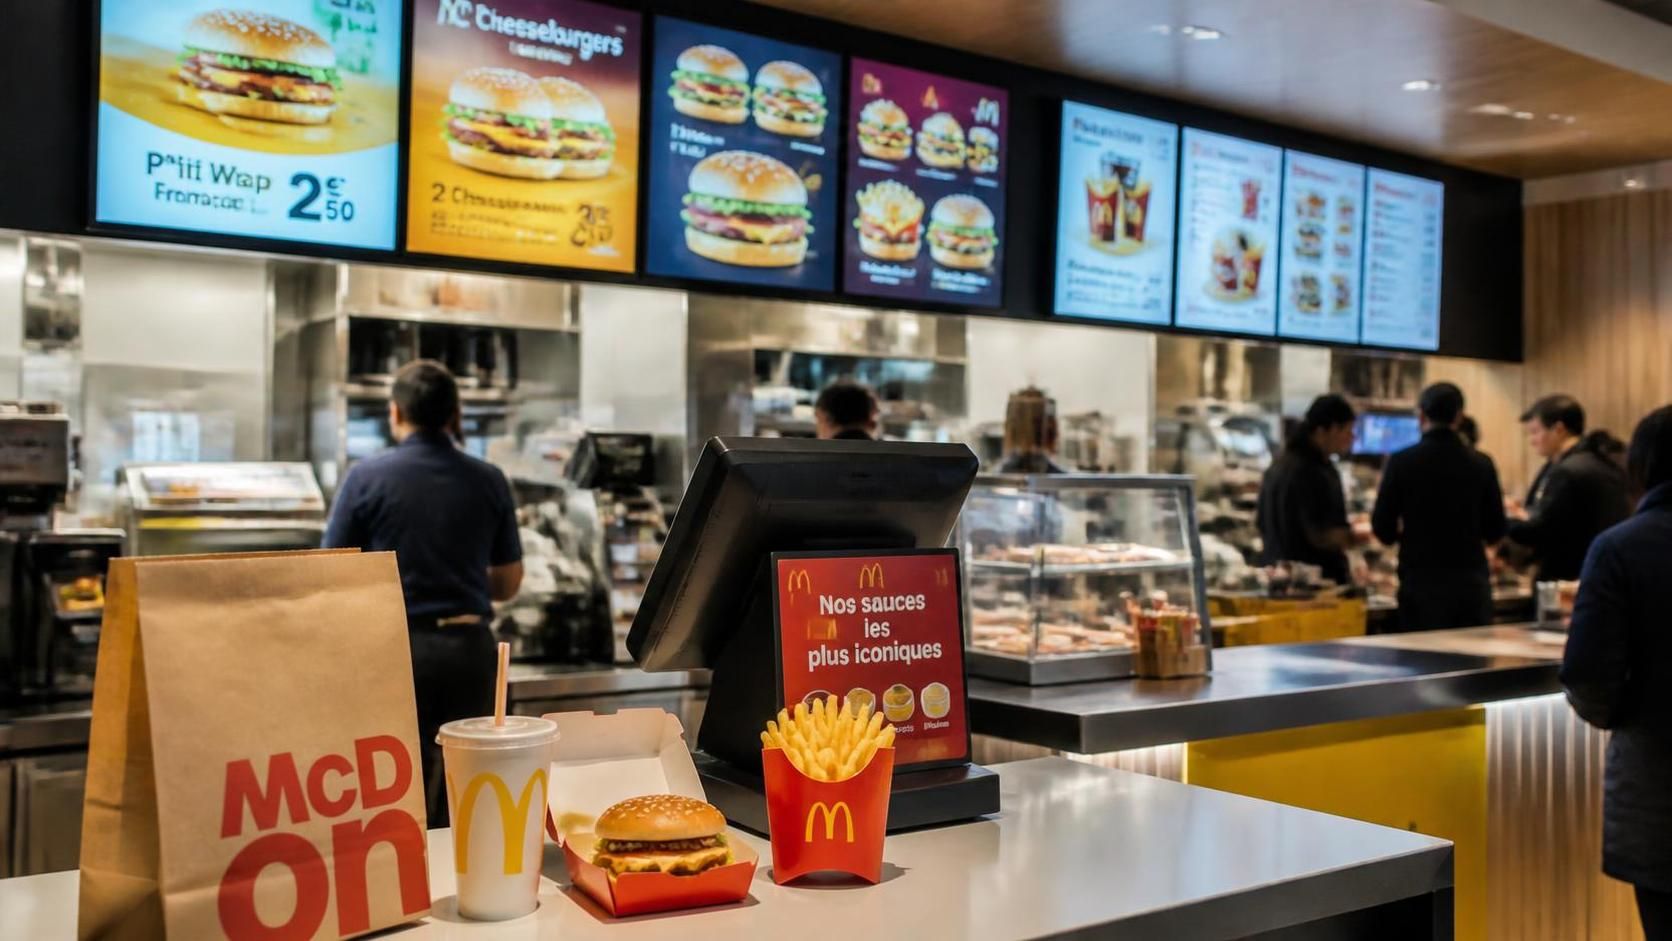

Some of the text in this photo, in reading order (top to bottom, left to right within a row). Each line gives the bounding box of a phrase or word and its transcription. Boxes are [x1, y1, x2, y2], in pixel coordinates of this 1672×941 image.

[326, 200, 354, 221] 50
[819, 594, 926, 616] Nos sauces
[808, 641, 943, 673] plus iconiques
[217, 808, 431, 941] on
